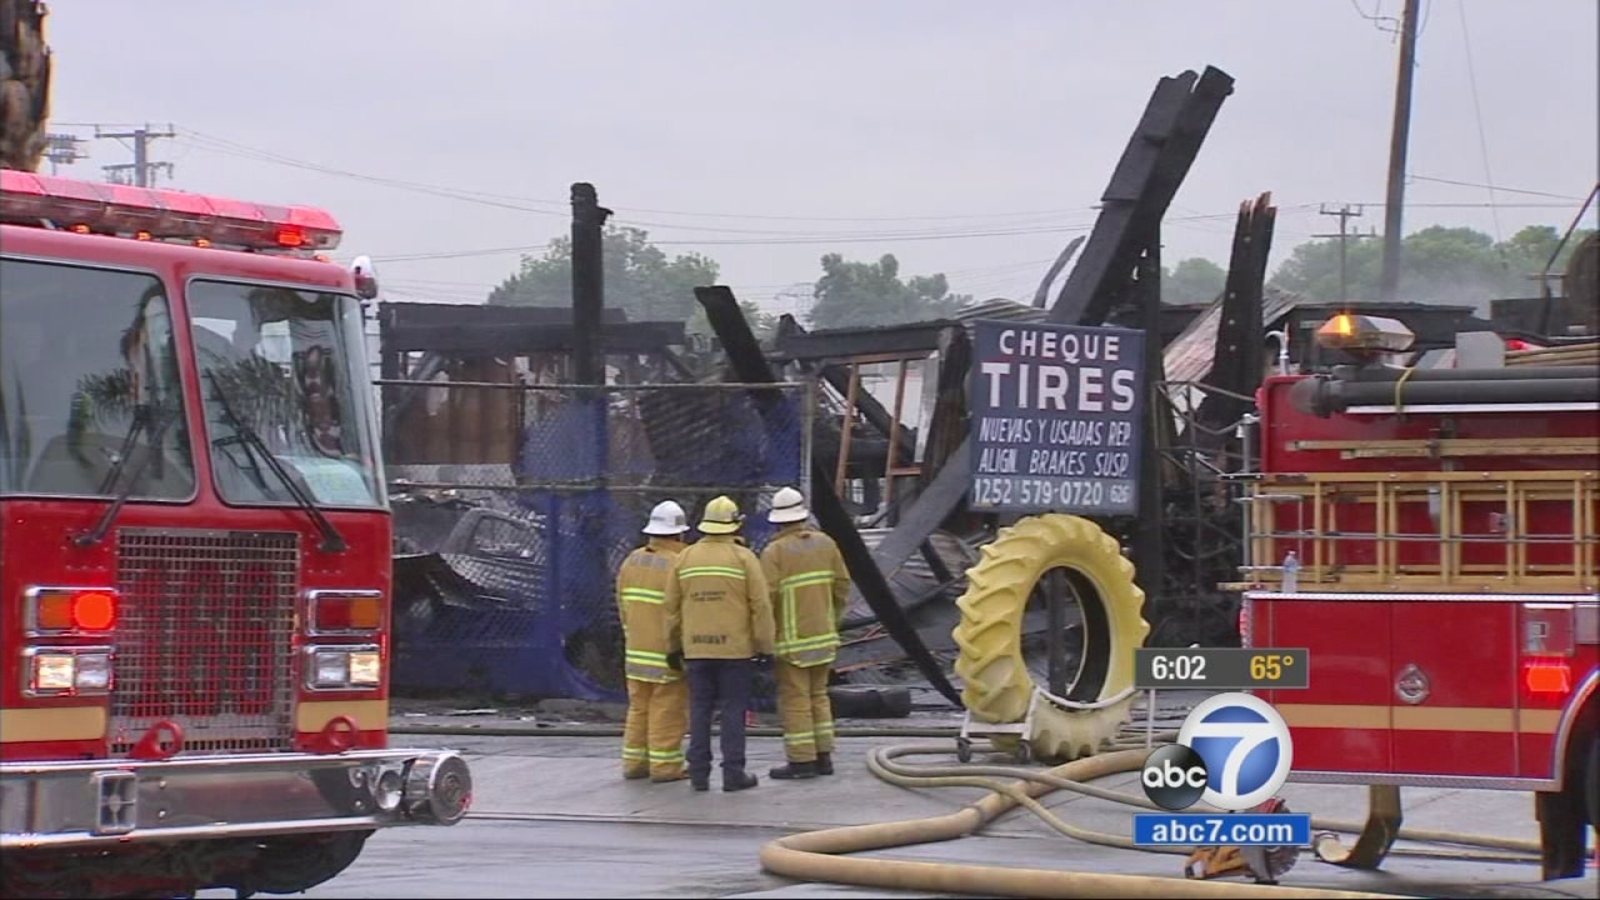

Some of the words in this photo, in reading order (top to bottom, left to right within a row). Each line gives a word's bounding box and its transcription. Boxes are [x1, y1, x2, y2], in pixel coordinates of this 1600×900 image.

[999, 329, 1120, 364] CHEQUE
[981, 362, 1135, 411] TIRES
[979, 417, 1032, 443] NUEVAS
[1038, 419, 1047, 444] Y
[1050, 420, 1104, 446] USADAS
[1029, 450, 1087, 475] BRAKES
[974, 478, 1012, 504] 1252
